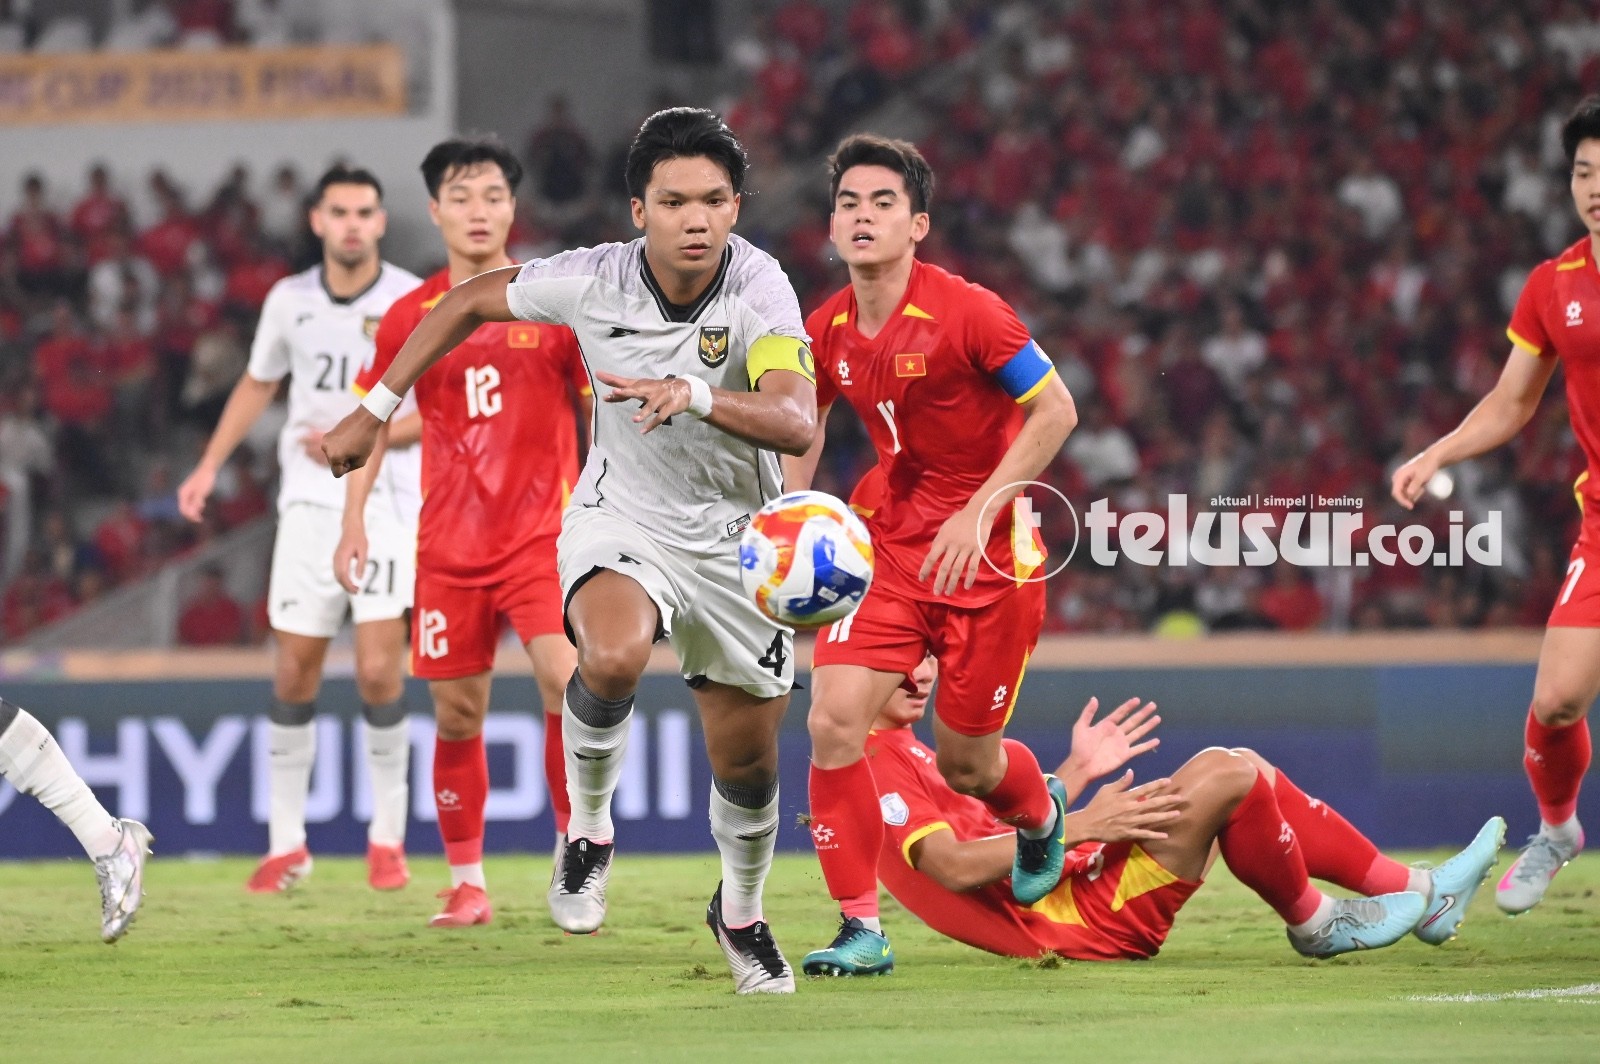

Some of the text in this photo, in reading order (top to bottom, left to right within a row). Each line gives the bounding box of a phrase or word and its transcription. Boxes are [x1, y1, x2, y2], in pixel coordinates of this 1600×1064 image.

[315, 347, 348, 391] 21
[465, 363, 502, 419] 12
[363, 558, 395, 595] 21
[419, 608, 449, 660] 12
[758, 629, 788, 678] 4
